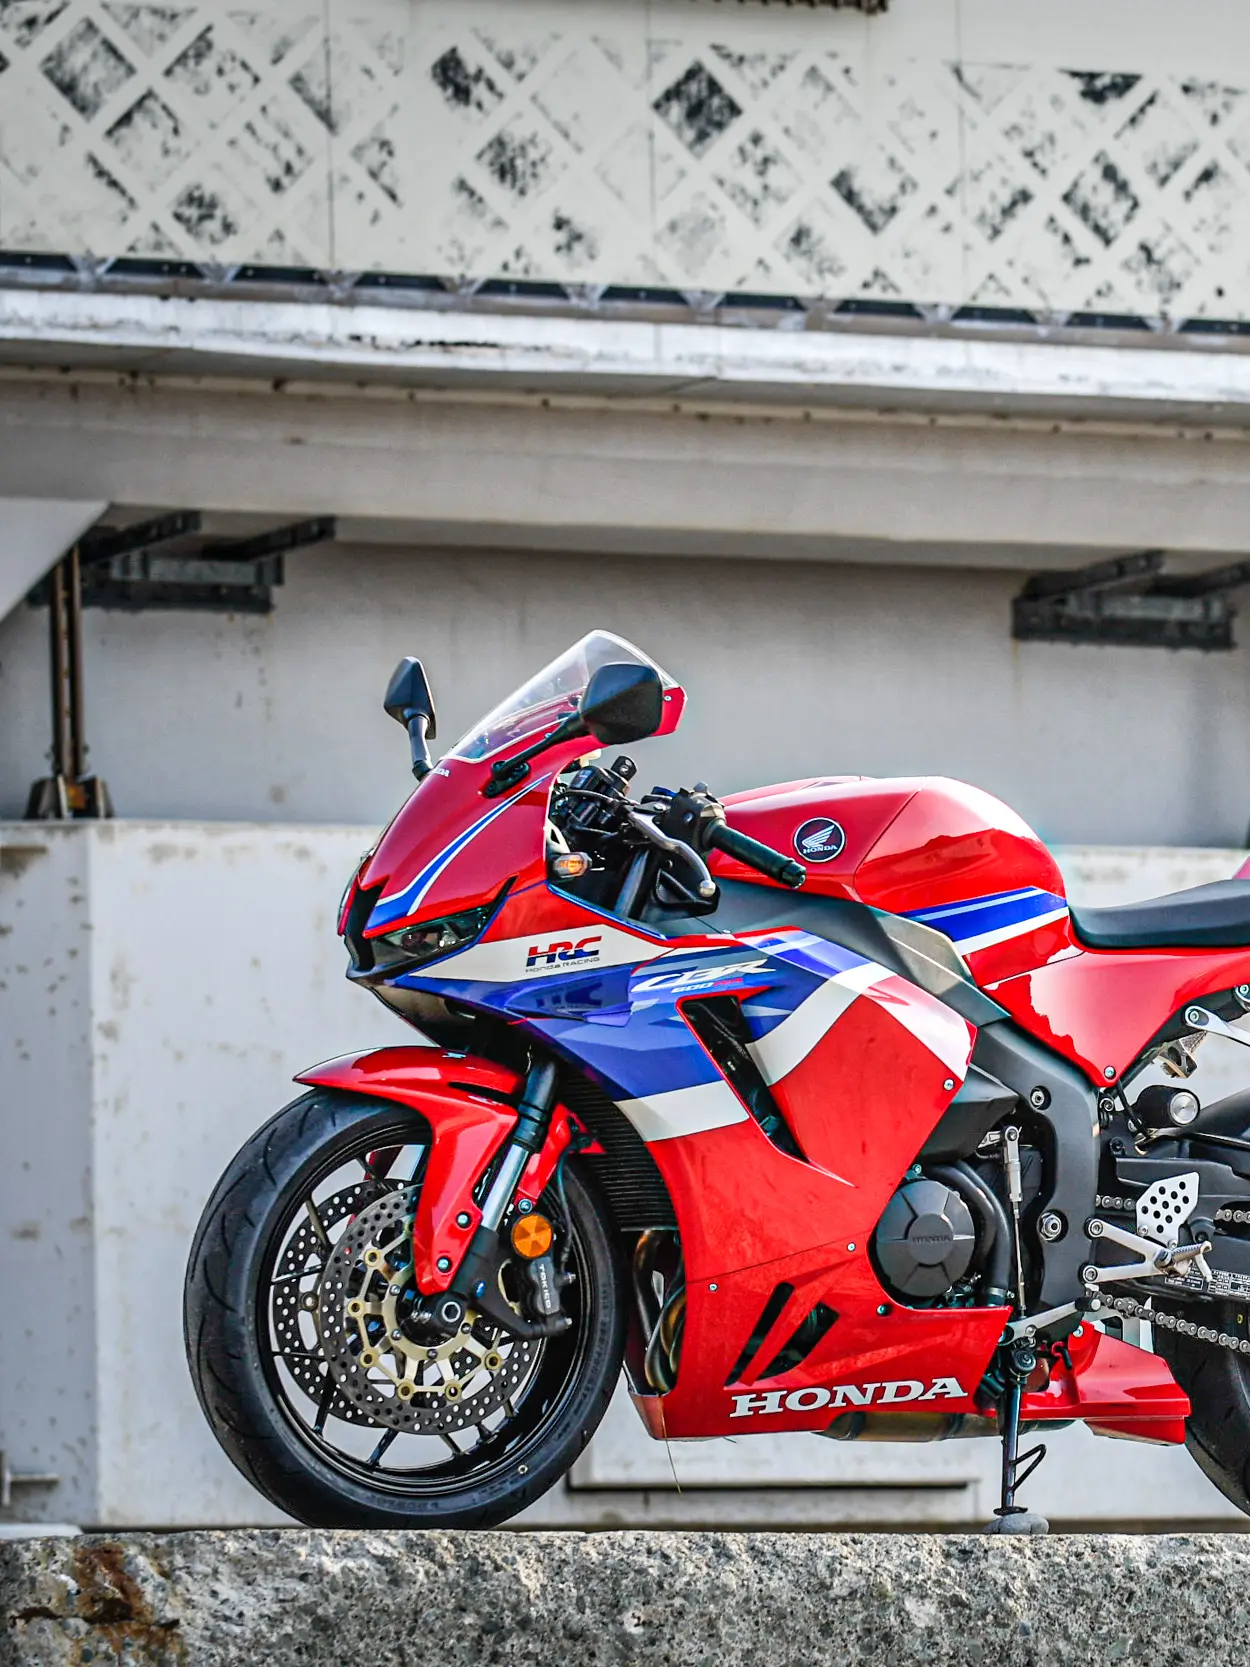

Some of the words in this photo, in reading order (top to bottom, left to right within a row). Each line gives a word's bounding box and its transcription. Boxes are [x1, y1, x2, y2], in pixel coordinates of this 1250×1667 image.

[802, 844, 838, 854] HONDA
[526, 935, 602, 967] HRC
[562, 956, 600, 967] RACING
[631, 958, 777, 992] CBR
[671, 977, 743, 993] 600RR
[911, 1234, 951, 1244] HONDA
[729, 1376, 969, 1418] HONDA
